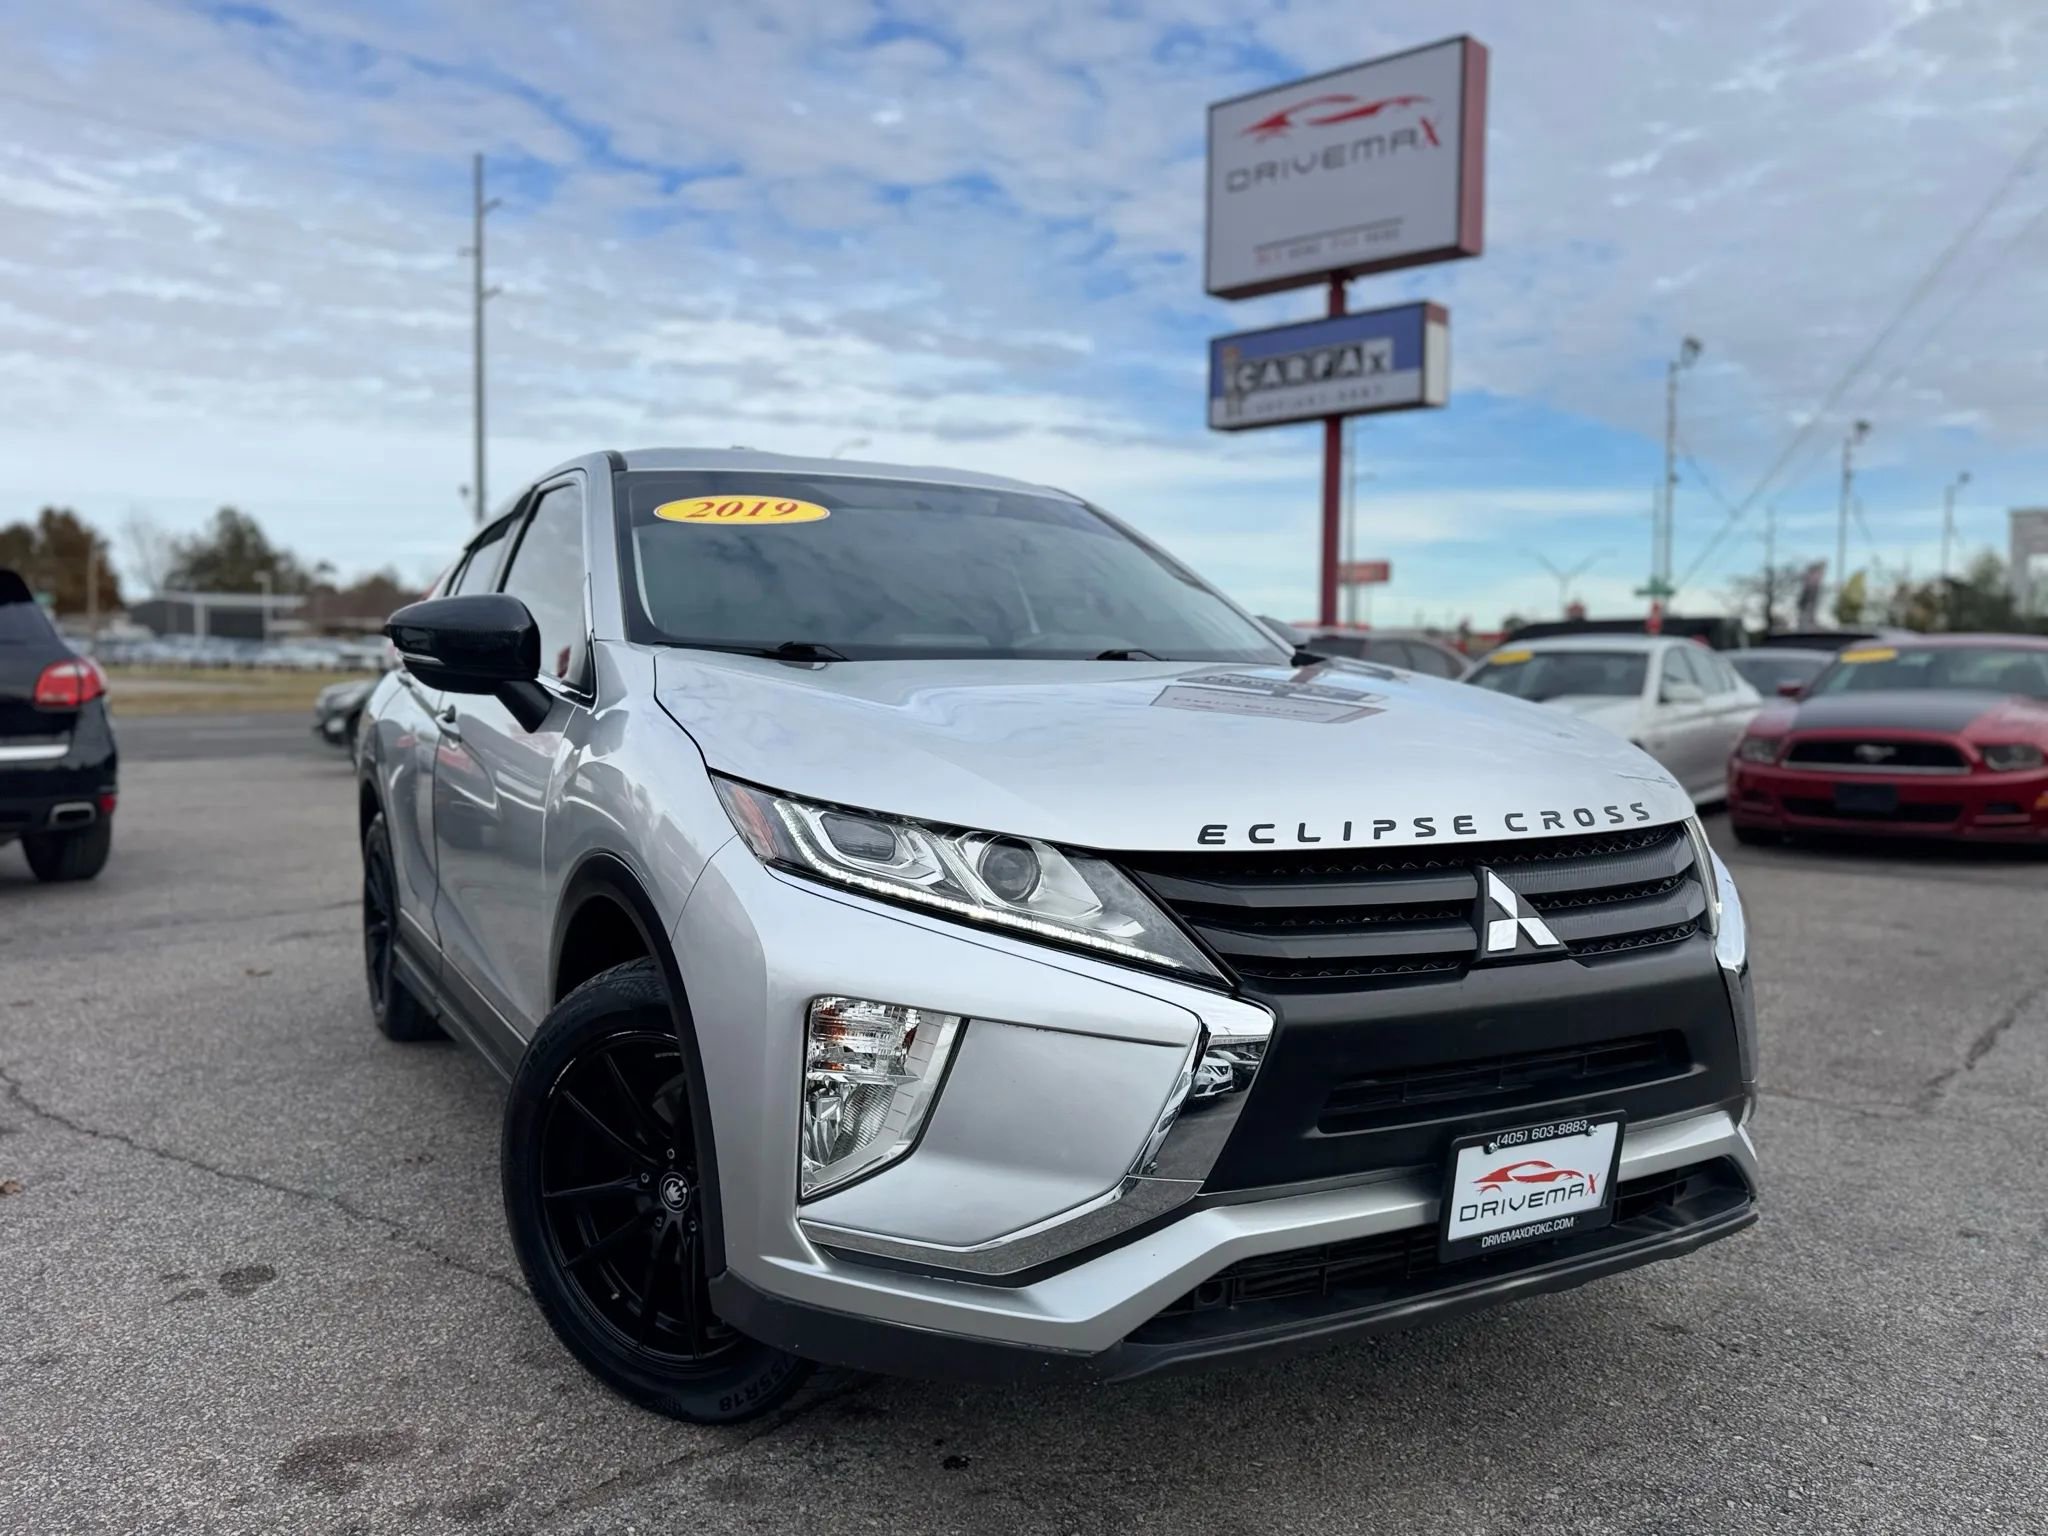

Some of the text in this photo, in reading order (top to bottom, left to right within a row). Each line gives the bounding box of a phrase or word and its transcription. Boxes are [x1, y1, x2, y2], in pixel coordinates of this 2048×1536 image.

[1224, 115, 1442, 194] DRIVEMAX
[686, 501, 799, 518] 2019
[1197, 802, 1651, 845] ECLIPSE CROSS
[1496, 1119, 1588, 1146] (405) 603-8883
[1459, 1172, 1600, 1222] DRIVEMAX
[1481, 1216, 1574, 1248] DRIVEMAXOFOKC.COM
